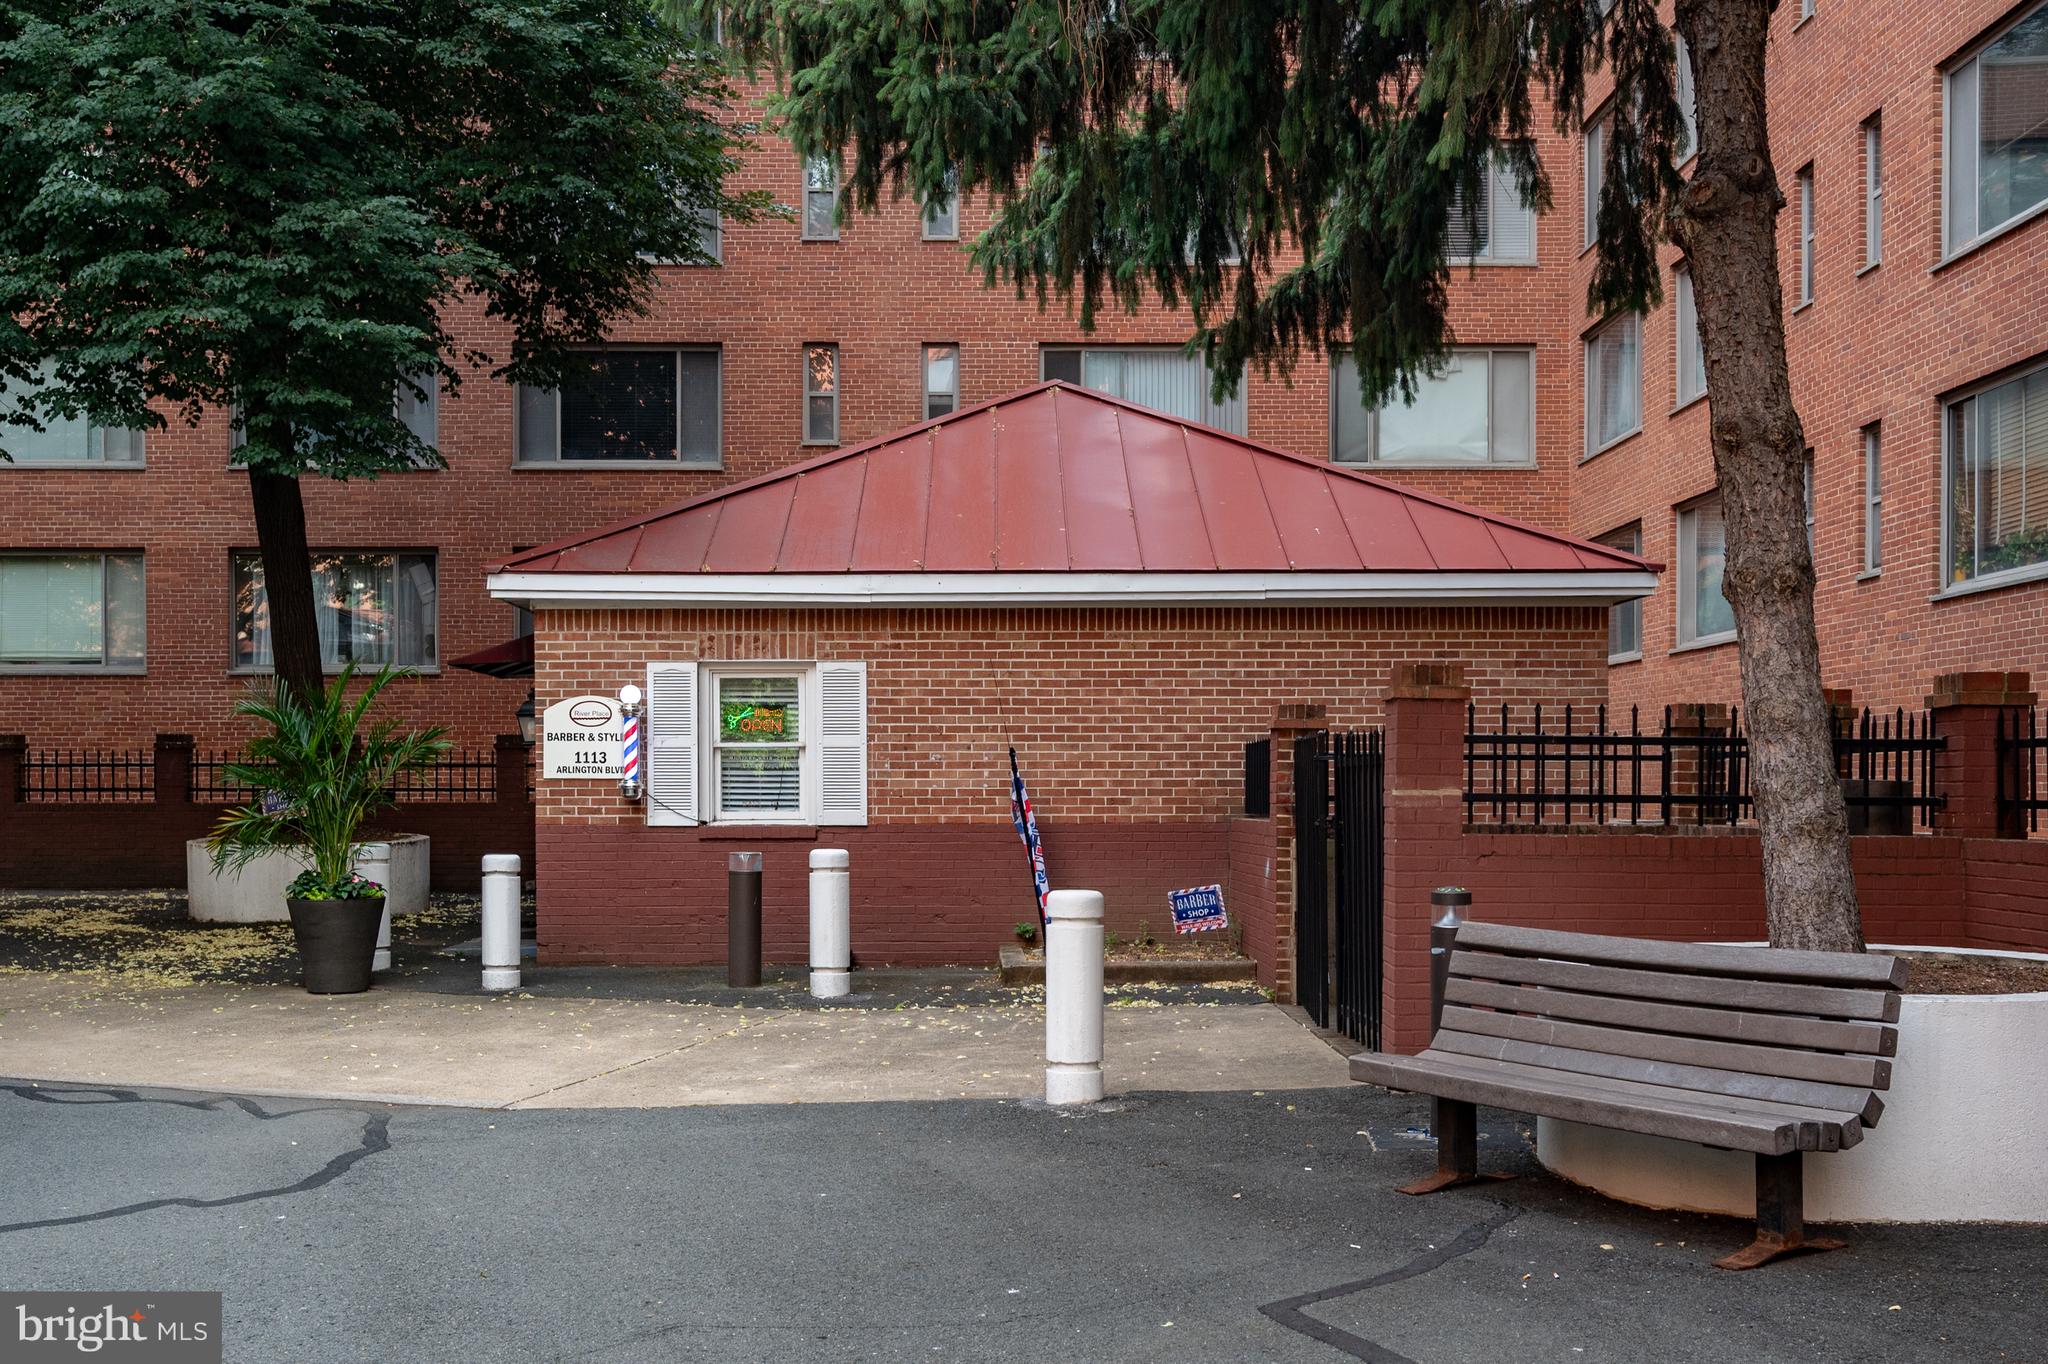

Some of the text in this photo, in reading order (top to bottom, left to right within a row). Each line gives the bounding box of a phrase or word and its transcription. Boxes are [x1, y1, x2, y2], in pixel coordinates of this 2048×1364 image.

[741, 718, 783, 734] OPEN
[547, 732, 585, 742] BARBER
[588, 732, 595, 742] &
[574, 751, 607, 764] 1113
[556, 766, 603, 774] ARLINGTON
[1176, 893, 1217, 910] BARBER
[1187, 909, 1209, 918] SHOP
